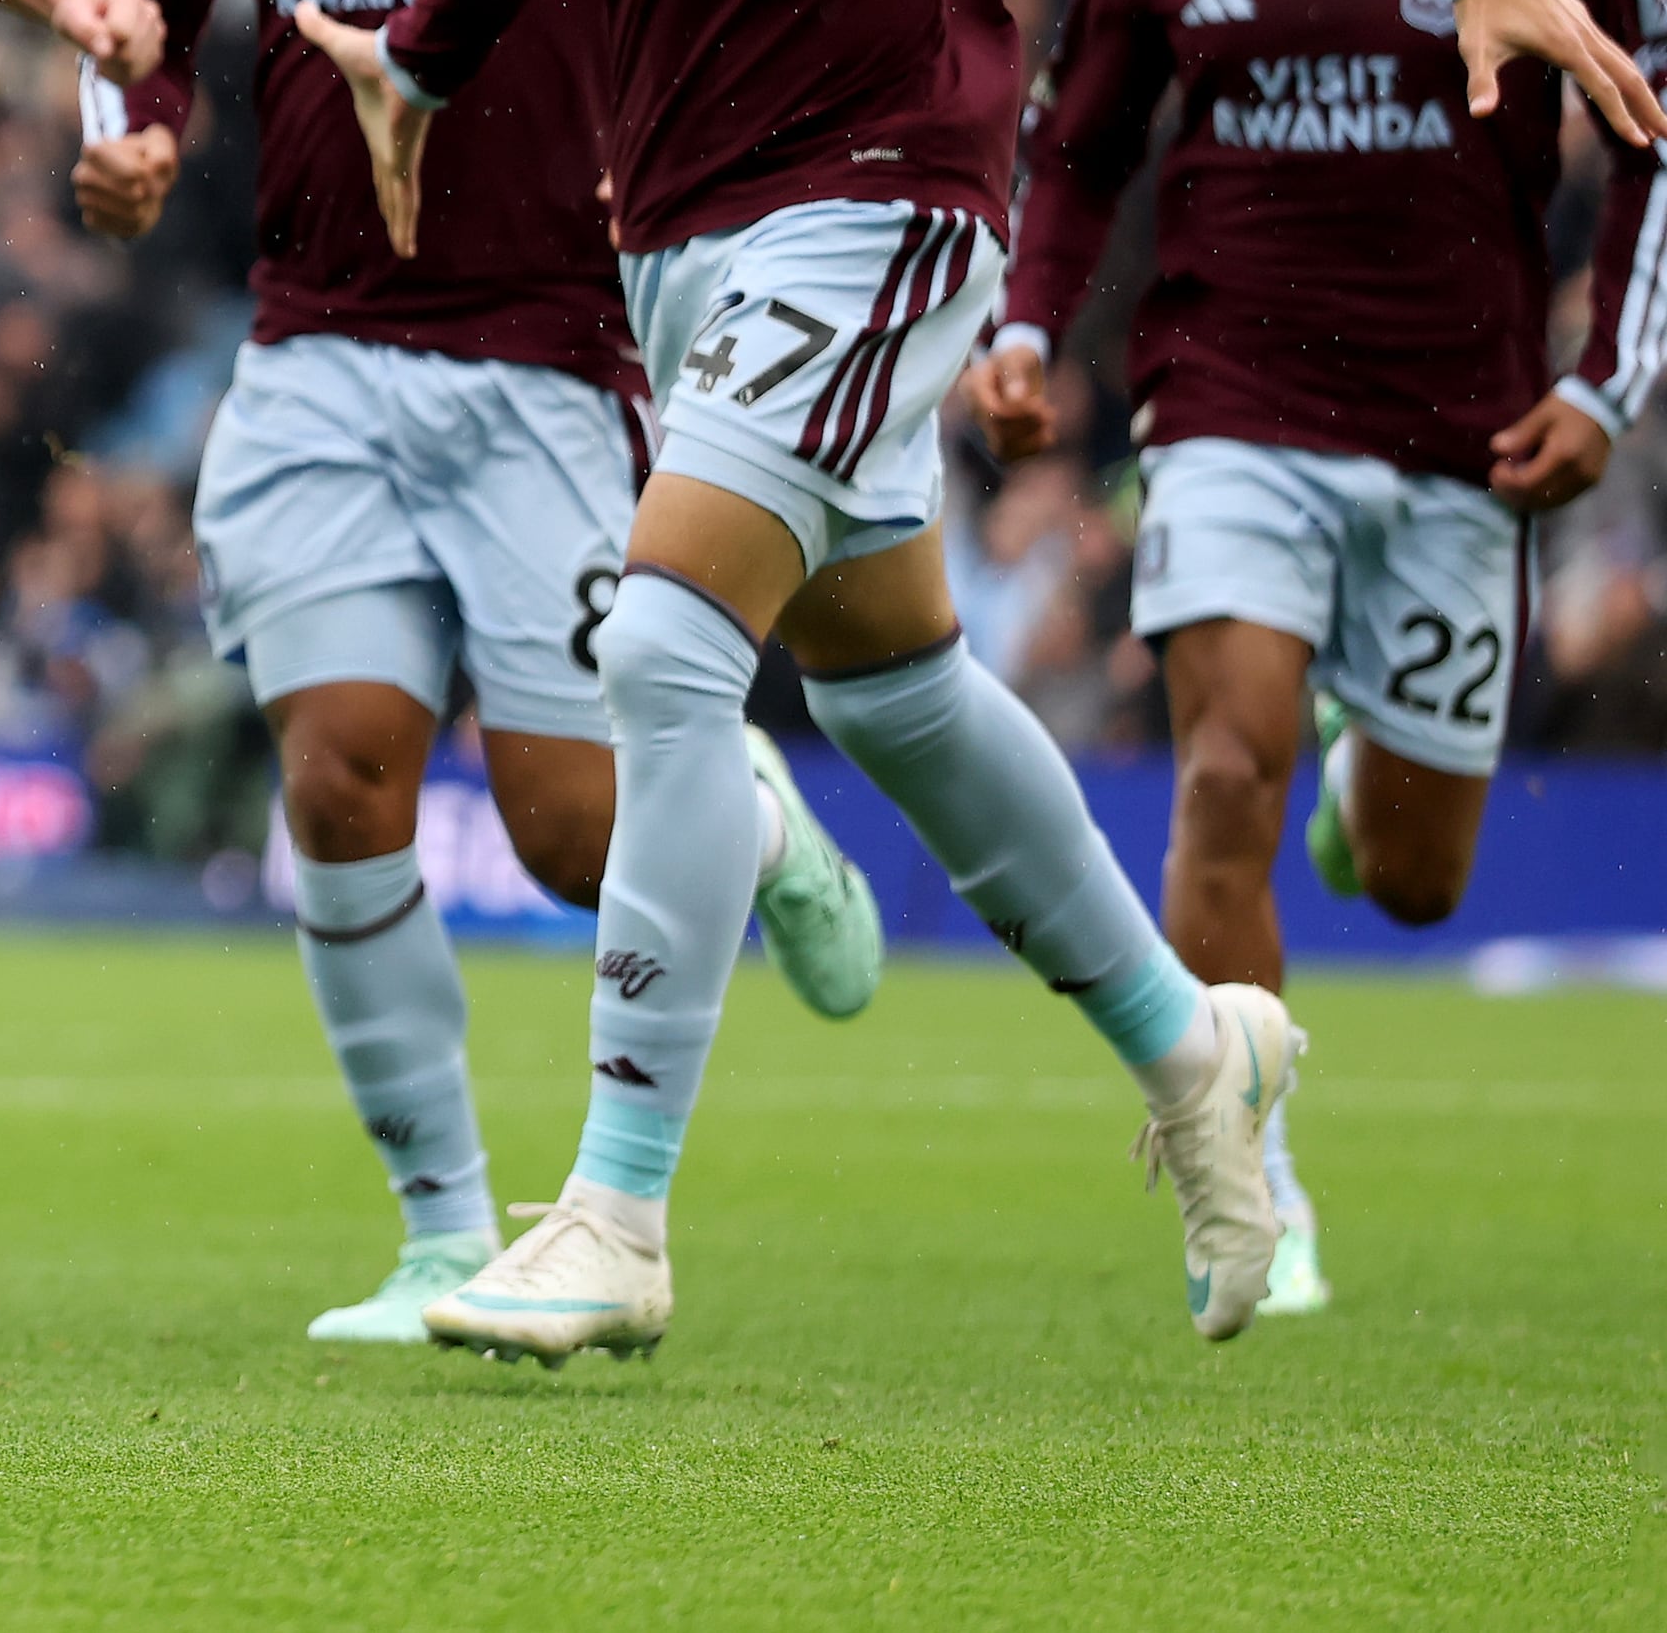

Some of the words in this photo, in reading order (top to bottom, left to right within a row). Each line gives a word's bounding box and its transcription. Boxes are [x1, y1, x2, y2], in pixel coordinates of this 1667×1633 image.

[1247, 54, 1402, 104] VISIT
[1212, 97, 1453, 153] RWANDA
[1387, 611, 1500, 726] 22
